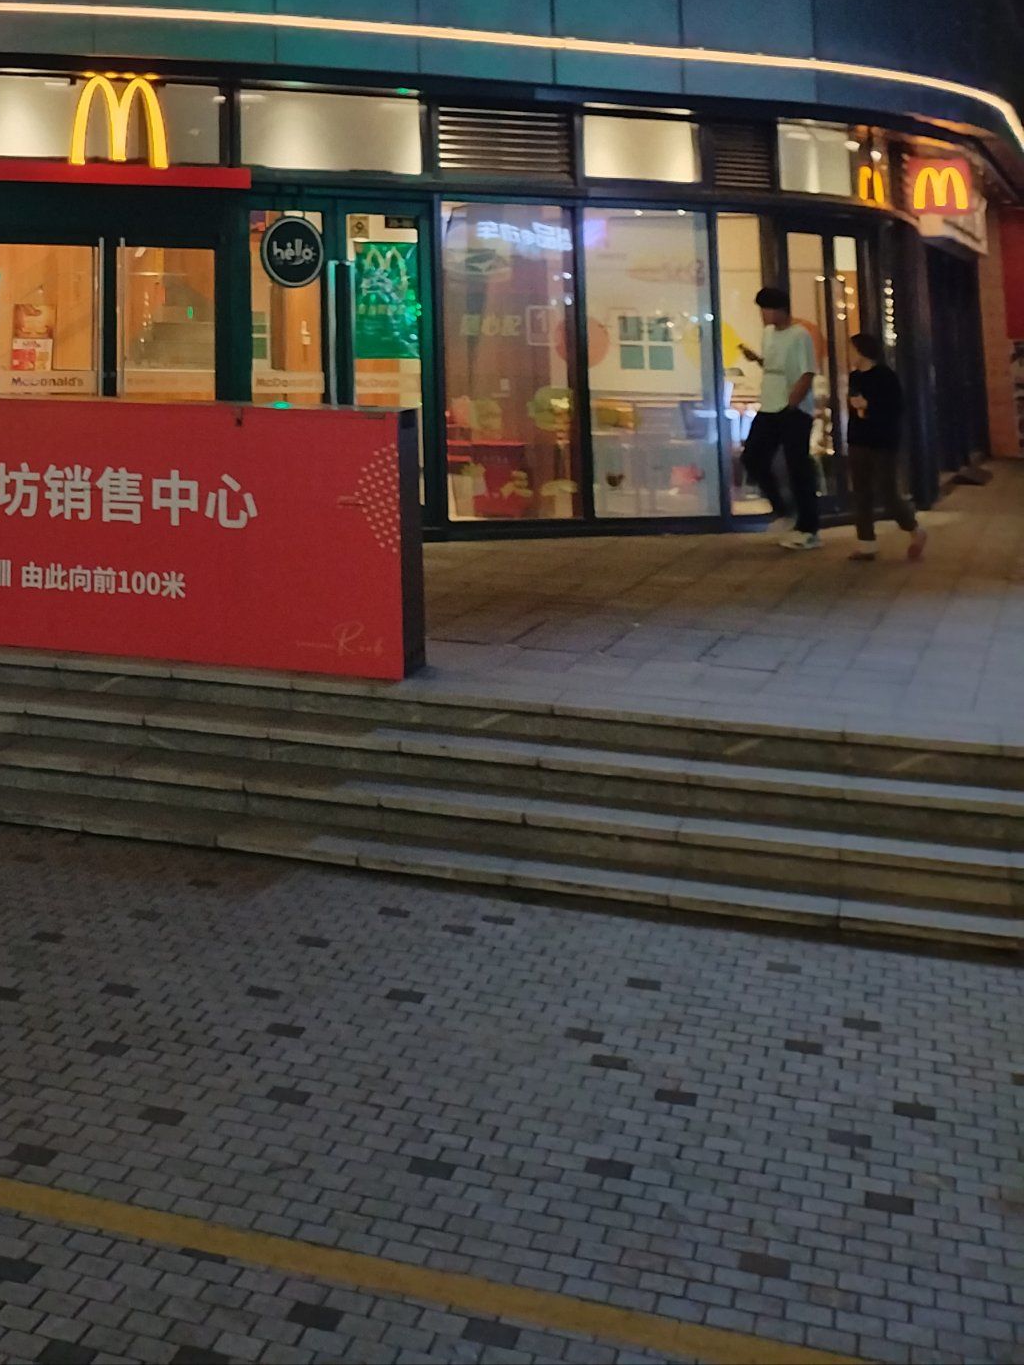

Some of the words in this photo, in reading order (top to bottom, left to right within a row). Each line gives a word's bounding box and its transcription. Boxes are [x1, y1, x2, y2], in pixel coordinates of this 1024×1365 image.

[20, 561, 187, 599] 由此向前100米
